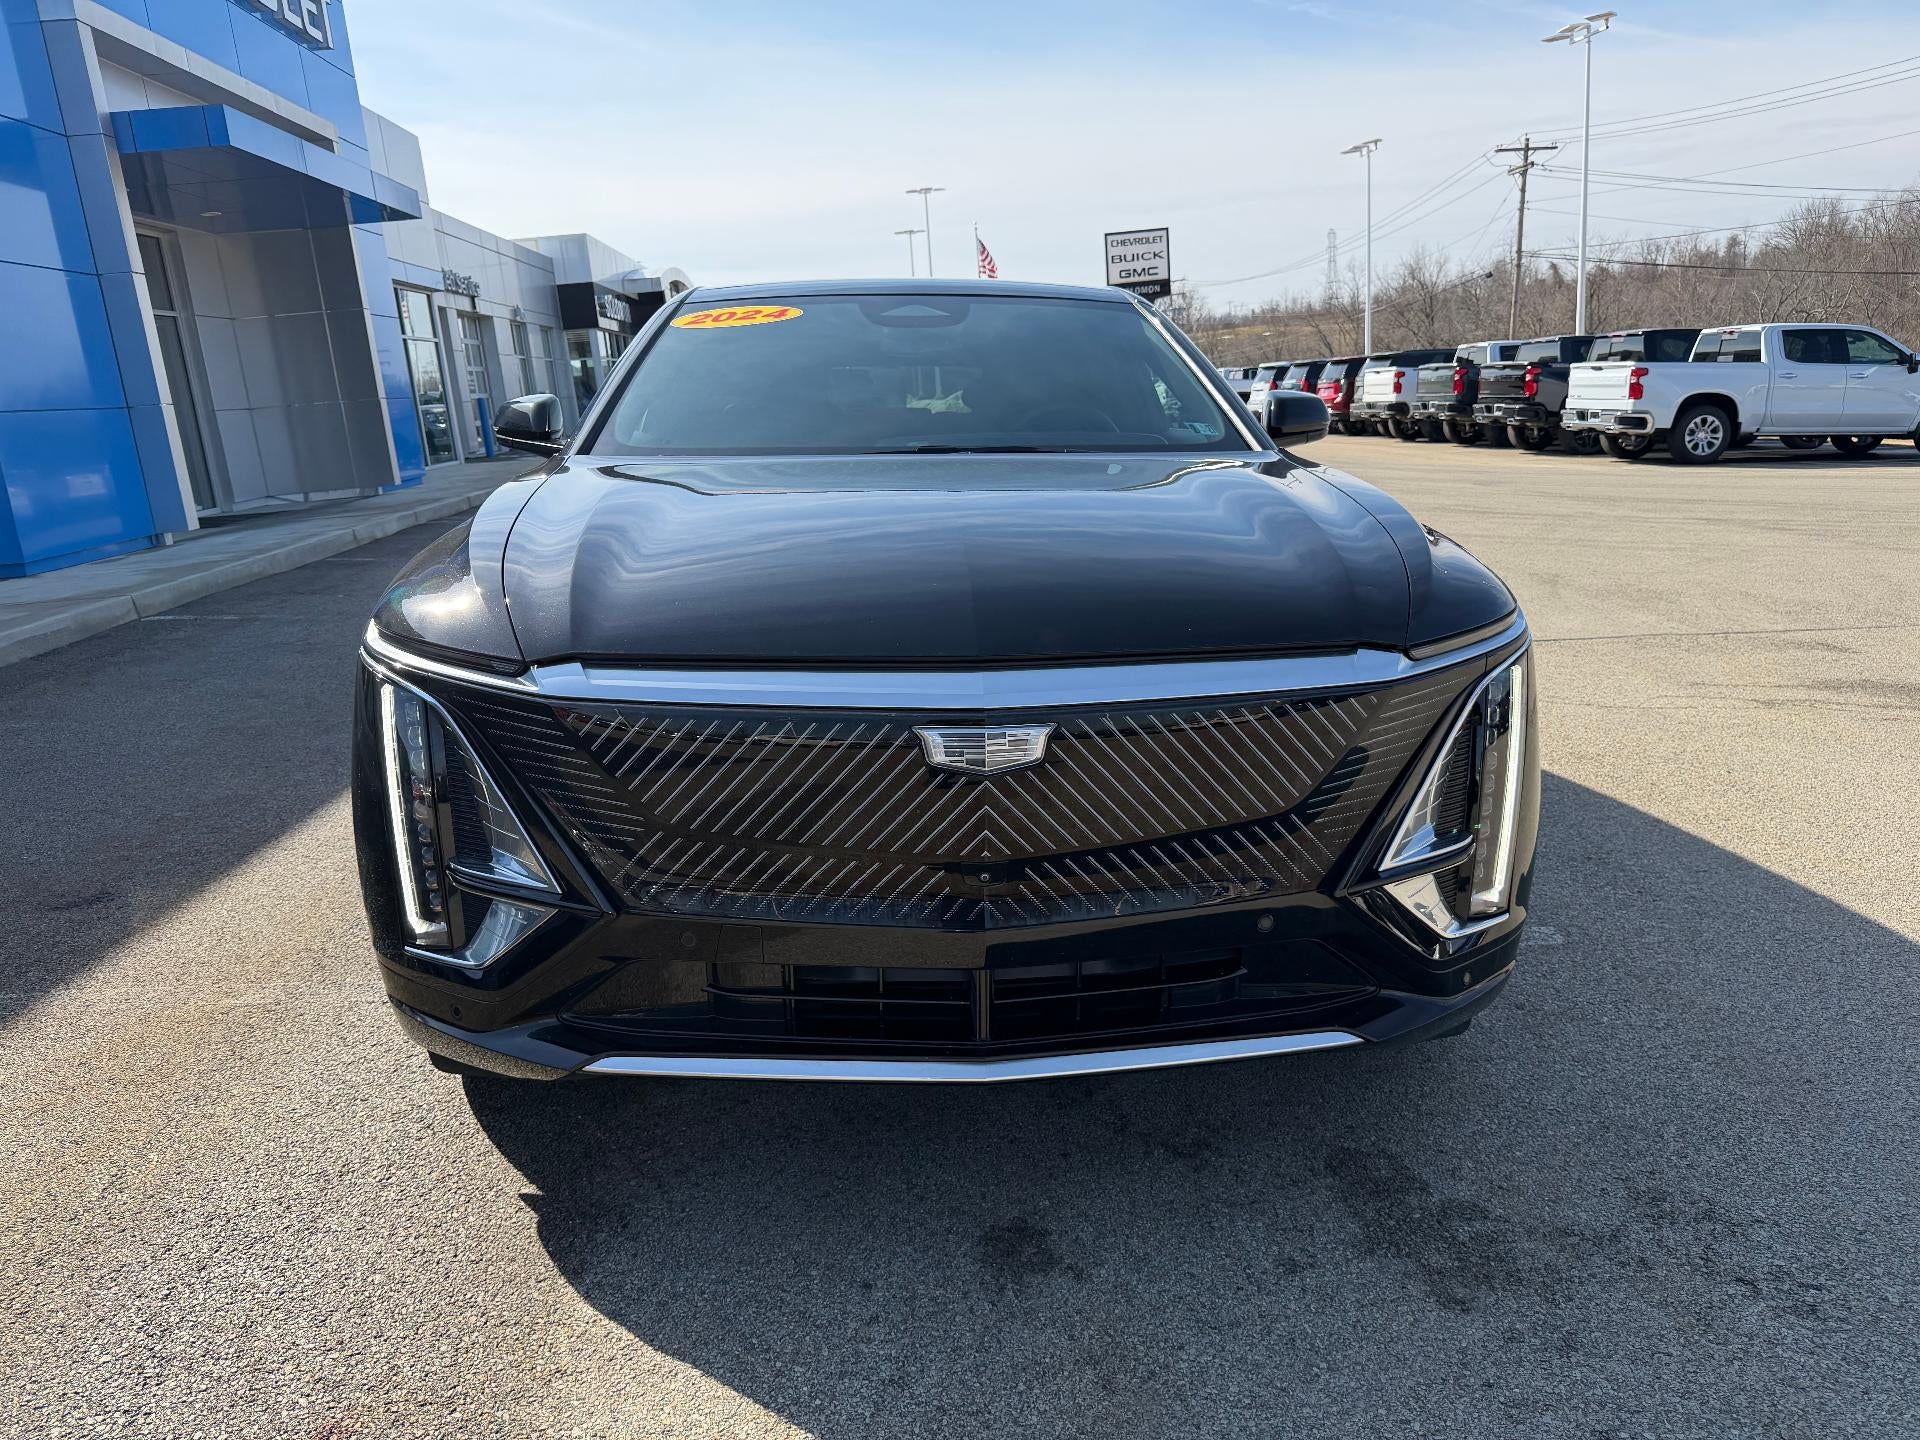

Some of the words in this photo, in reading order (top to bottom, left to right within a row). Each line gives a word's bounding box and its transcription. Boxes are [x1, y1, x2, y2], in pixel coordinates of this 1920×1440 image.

[1111, 236, 1164, 248] CHEVROLET
[1111, 251, 1164, 264] BUICK
[1119, 267, 1159, 279] GMC
[683, 308, 791, 326] 2024
